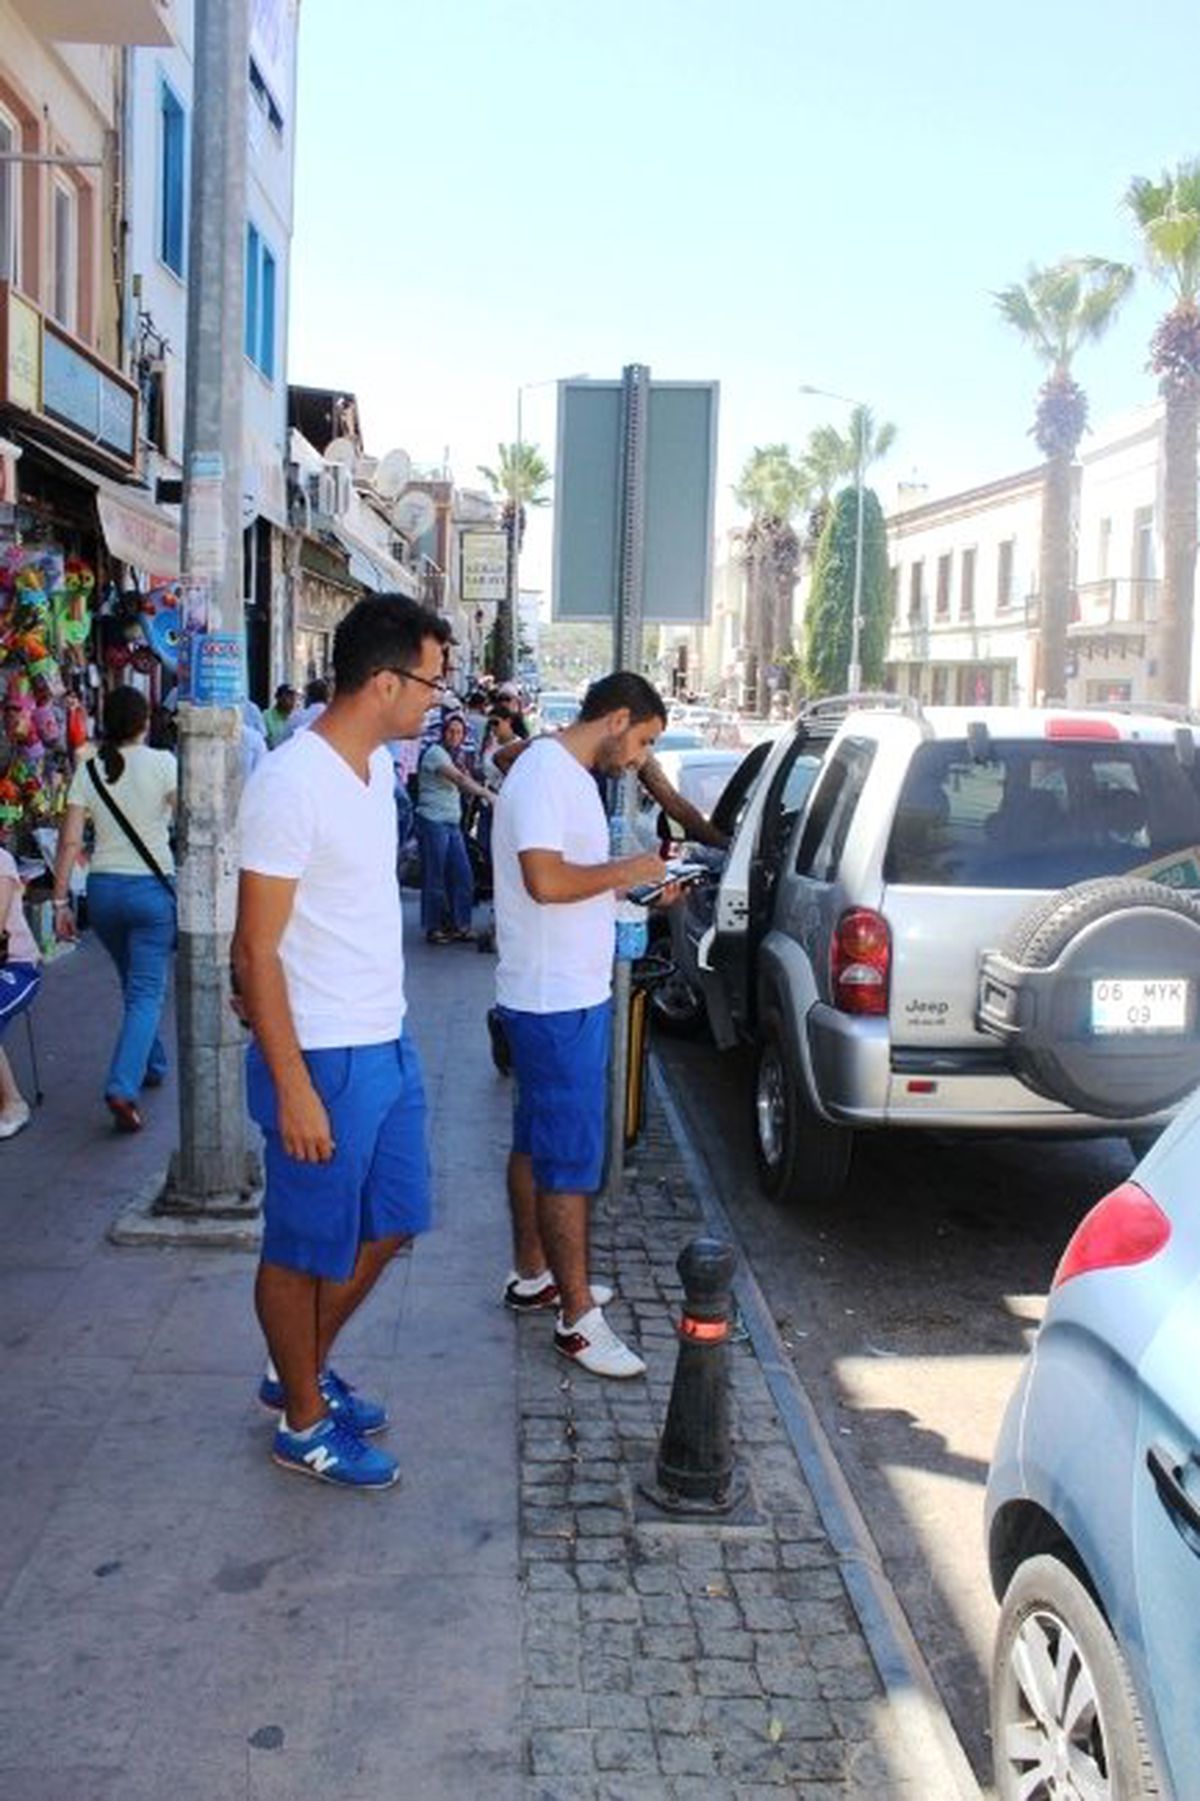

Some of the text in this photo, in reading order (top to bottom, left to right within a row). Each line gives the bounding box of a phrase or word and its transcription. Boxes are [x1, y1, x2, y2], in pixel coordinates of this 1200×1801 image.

[1097, 983, 1182, 1001] 06 MYK
[905, 999, 949, 1014] Jeep
